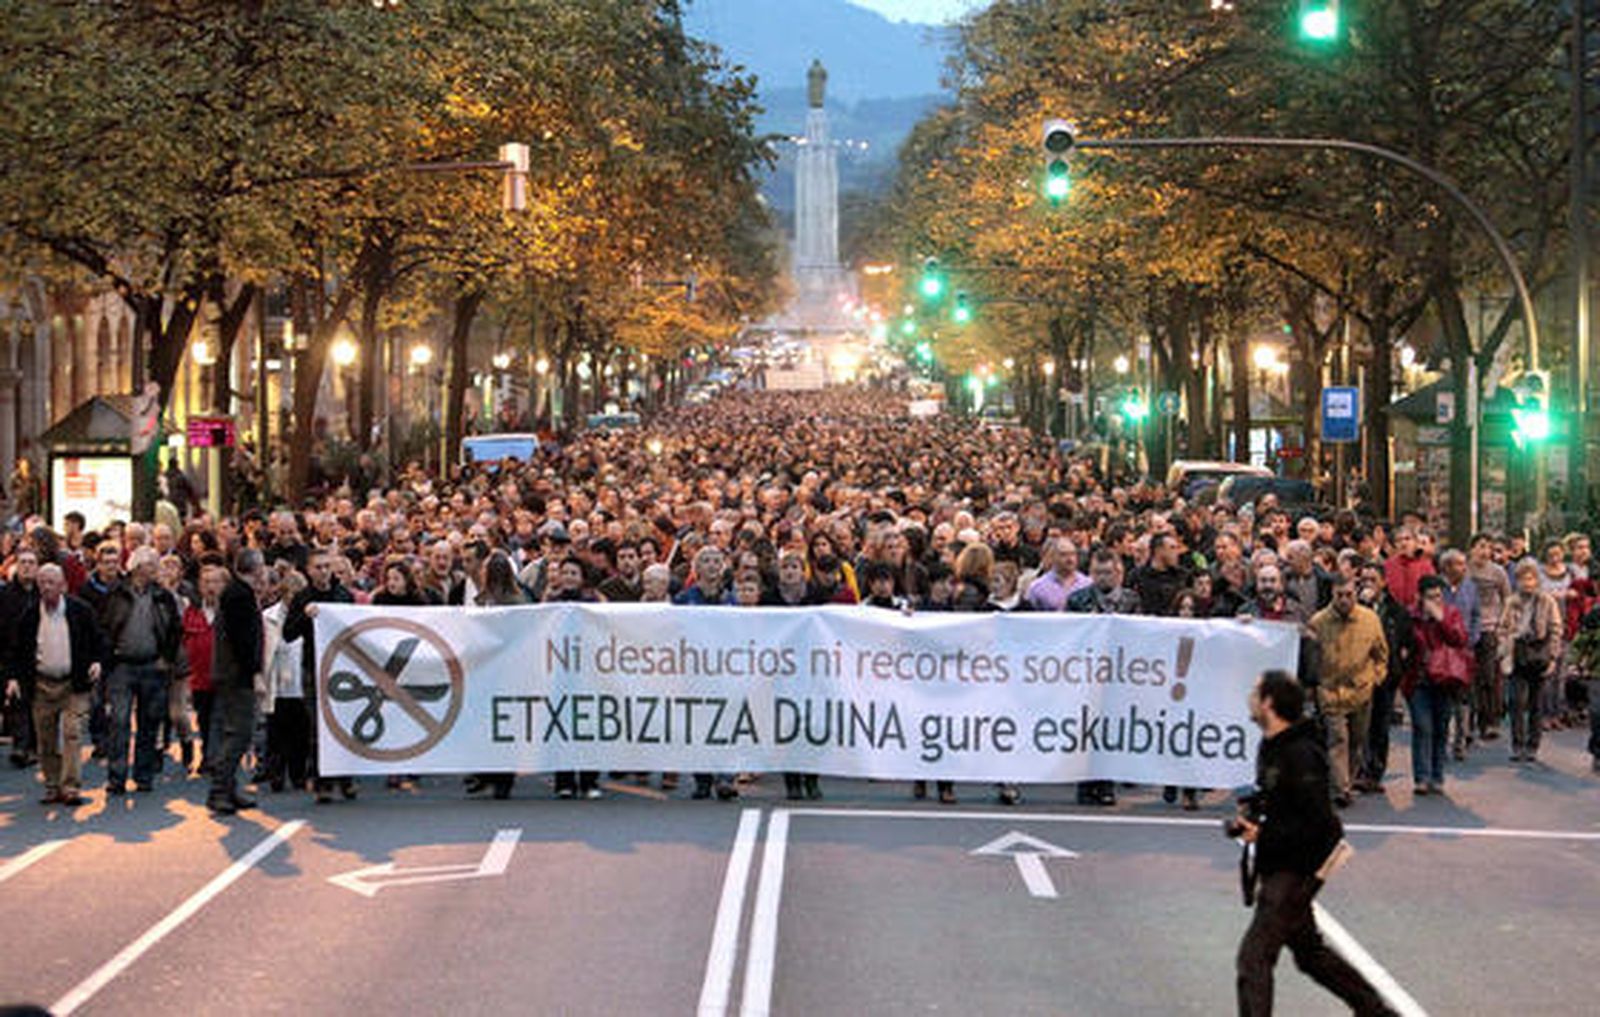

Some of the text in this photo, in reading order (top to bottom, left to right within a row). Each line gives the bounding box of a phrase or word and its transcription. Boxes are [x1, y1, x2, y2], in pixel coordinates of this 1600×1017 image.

[546, 635, 582, 674] Ni
[595, 637, 797, 677] desahucios
[810, 641, 843, 678] ni
[856, 648, 1010, 683] recortes
[491, 694, 1248, 763] ETXEBIZITZA DUINA gure eskubidea
